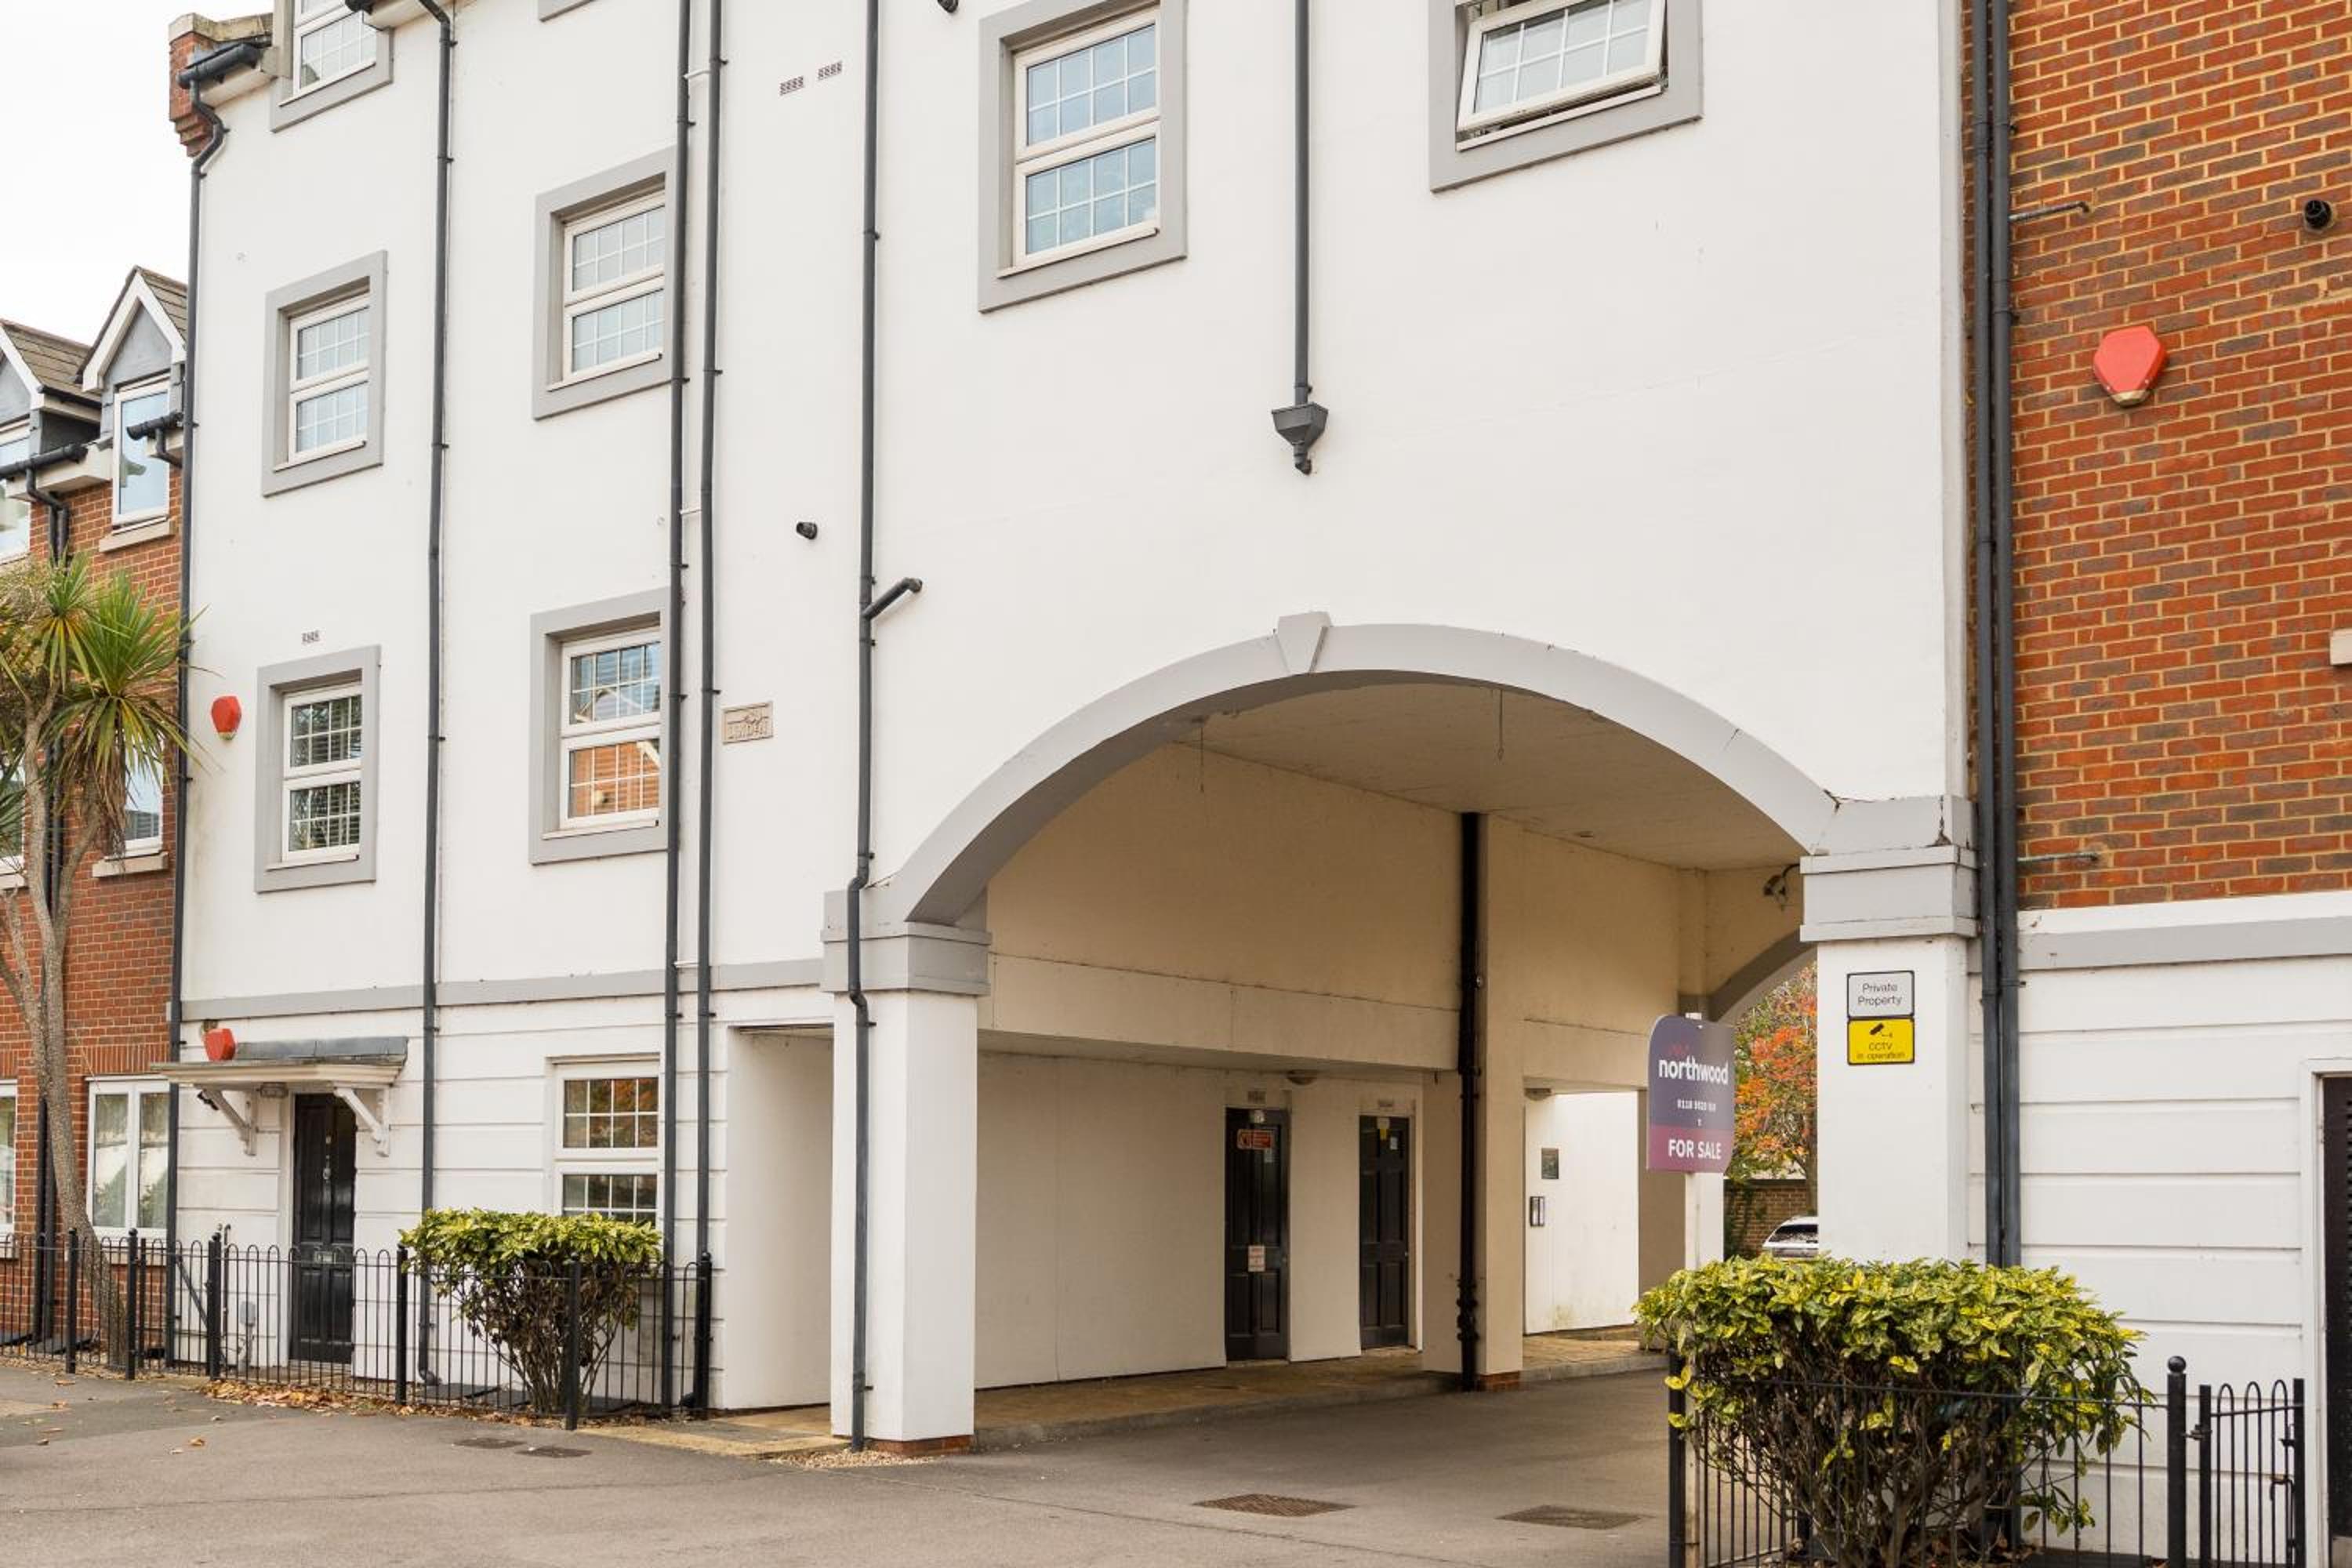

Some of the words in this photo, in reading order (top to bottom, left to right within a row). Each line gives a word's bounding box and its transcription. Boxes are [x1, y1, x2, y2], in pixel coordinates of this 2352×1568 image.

[1857, 996, 1903, 1007] Property
[1868, 1042, 1893, 1051] CCTV
[1658, 1055, 1729, 1085] northwood
[1668, 1139, 1694, 1158] FOR
[1697, 1141, 1722, 1160] SALE
